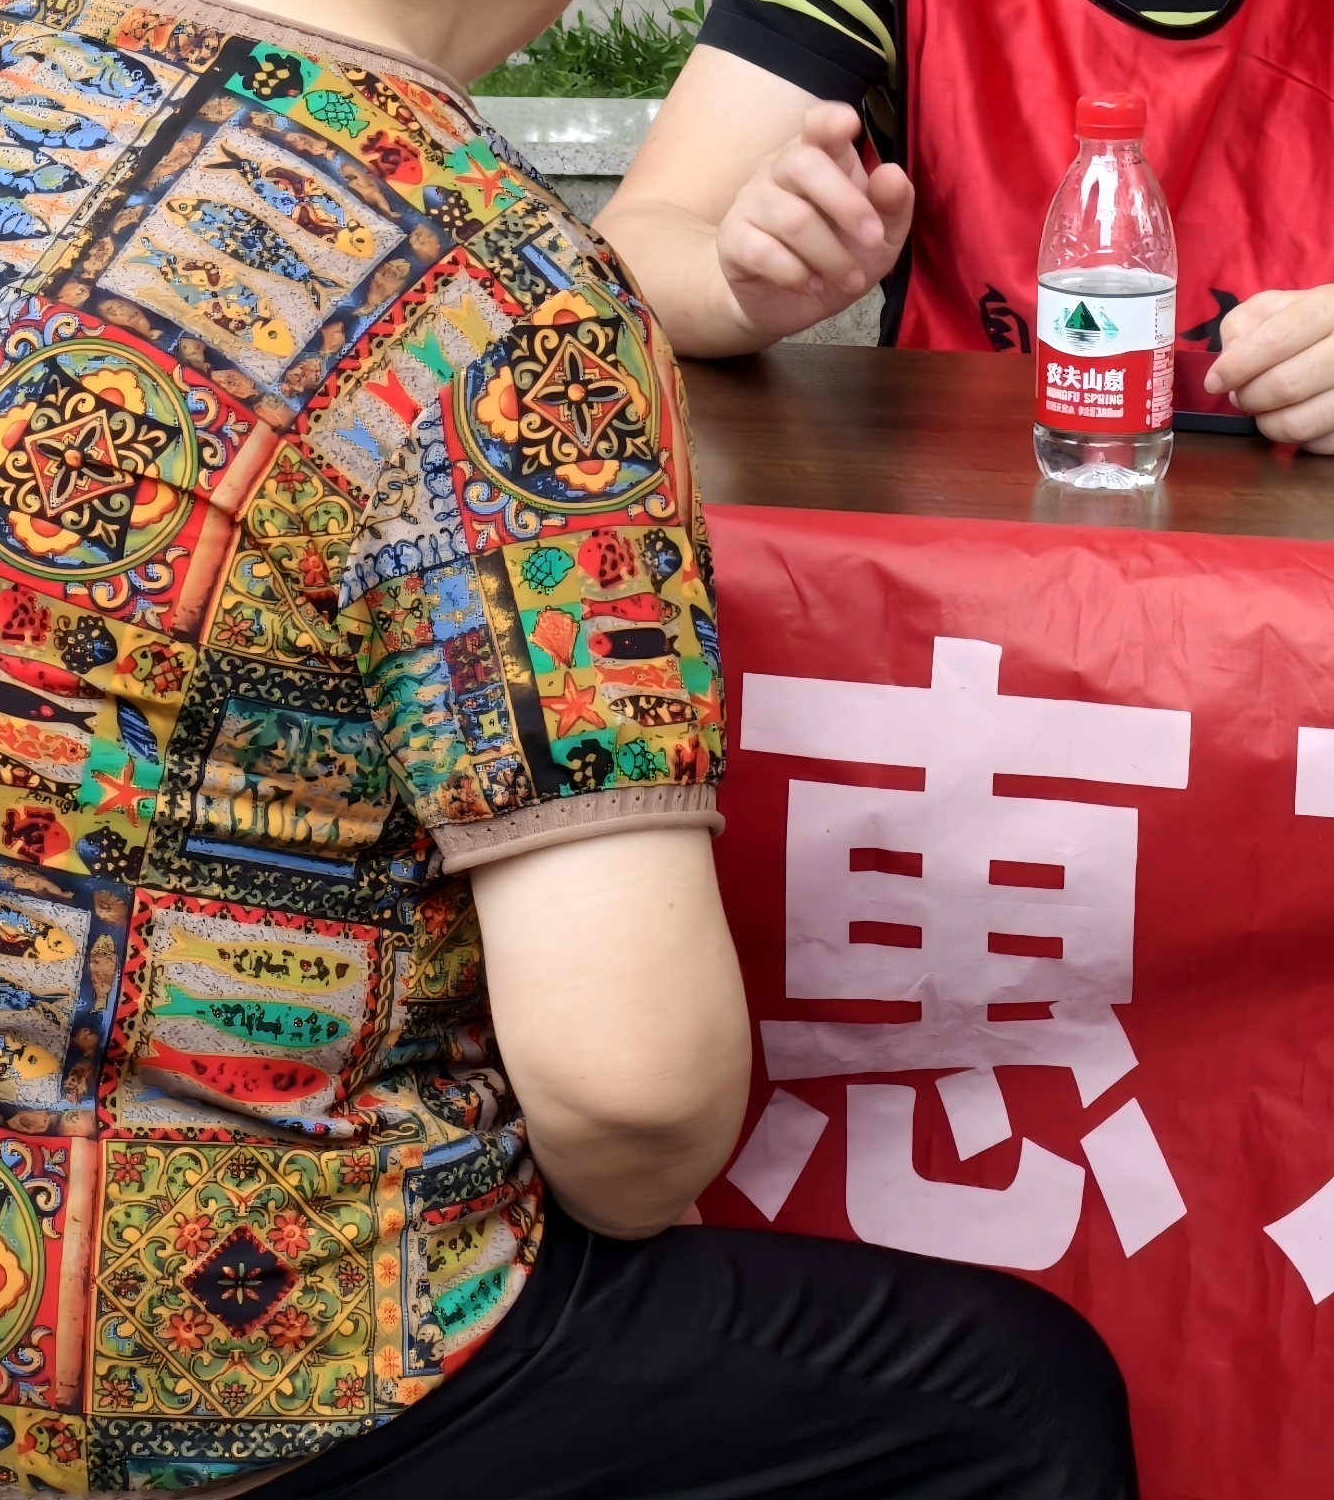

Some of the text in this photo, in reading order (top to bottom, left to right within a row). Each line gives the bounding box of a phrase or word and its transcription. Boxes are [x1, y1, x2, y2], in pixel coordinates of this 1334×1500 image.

[1046, 362, 1124, 392] 农夫山泉
[1083, 392, 1124, 405] SPRING
